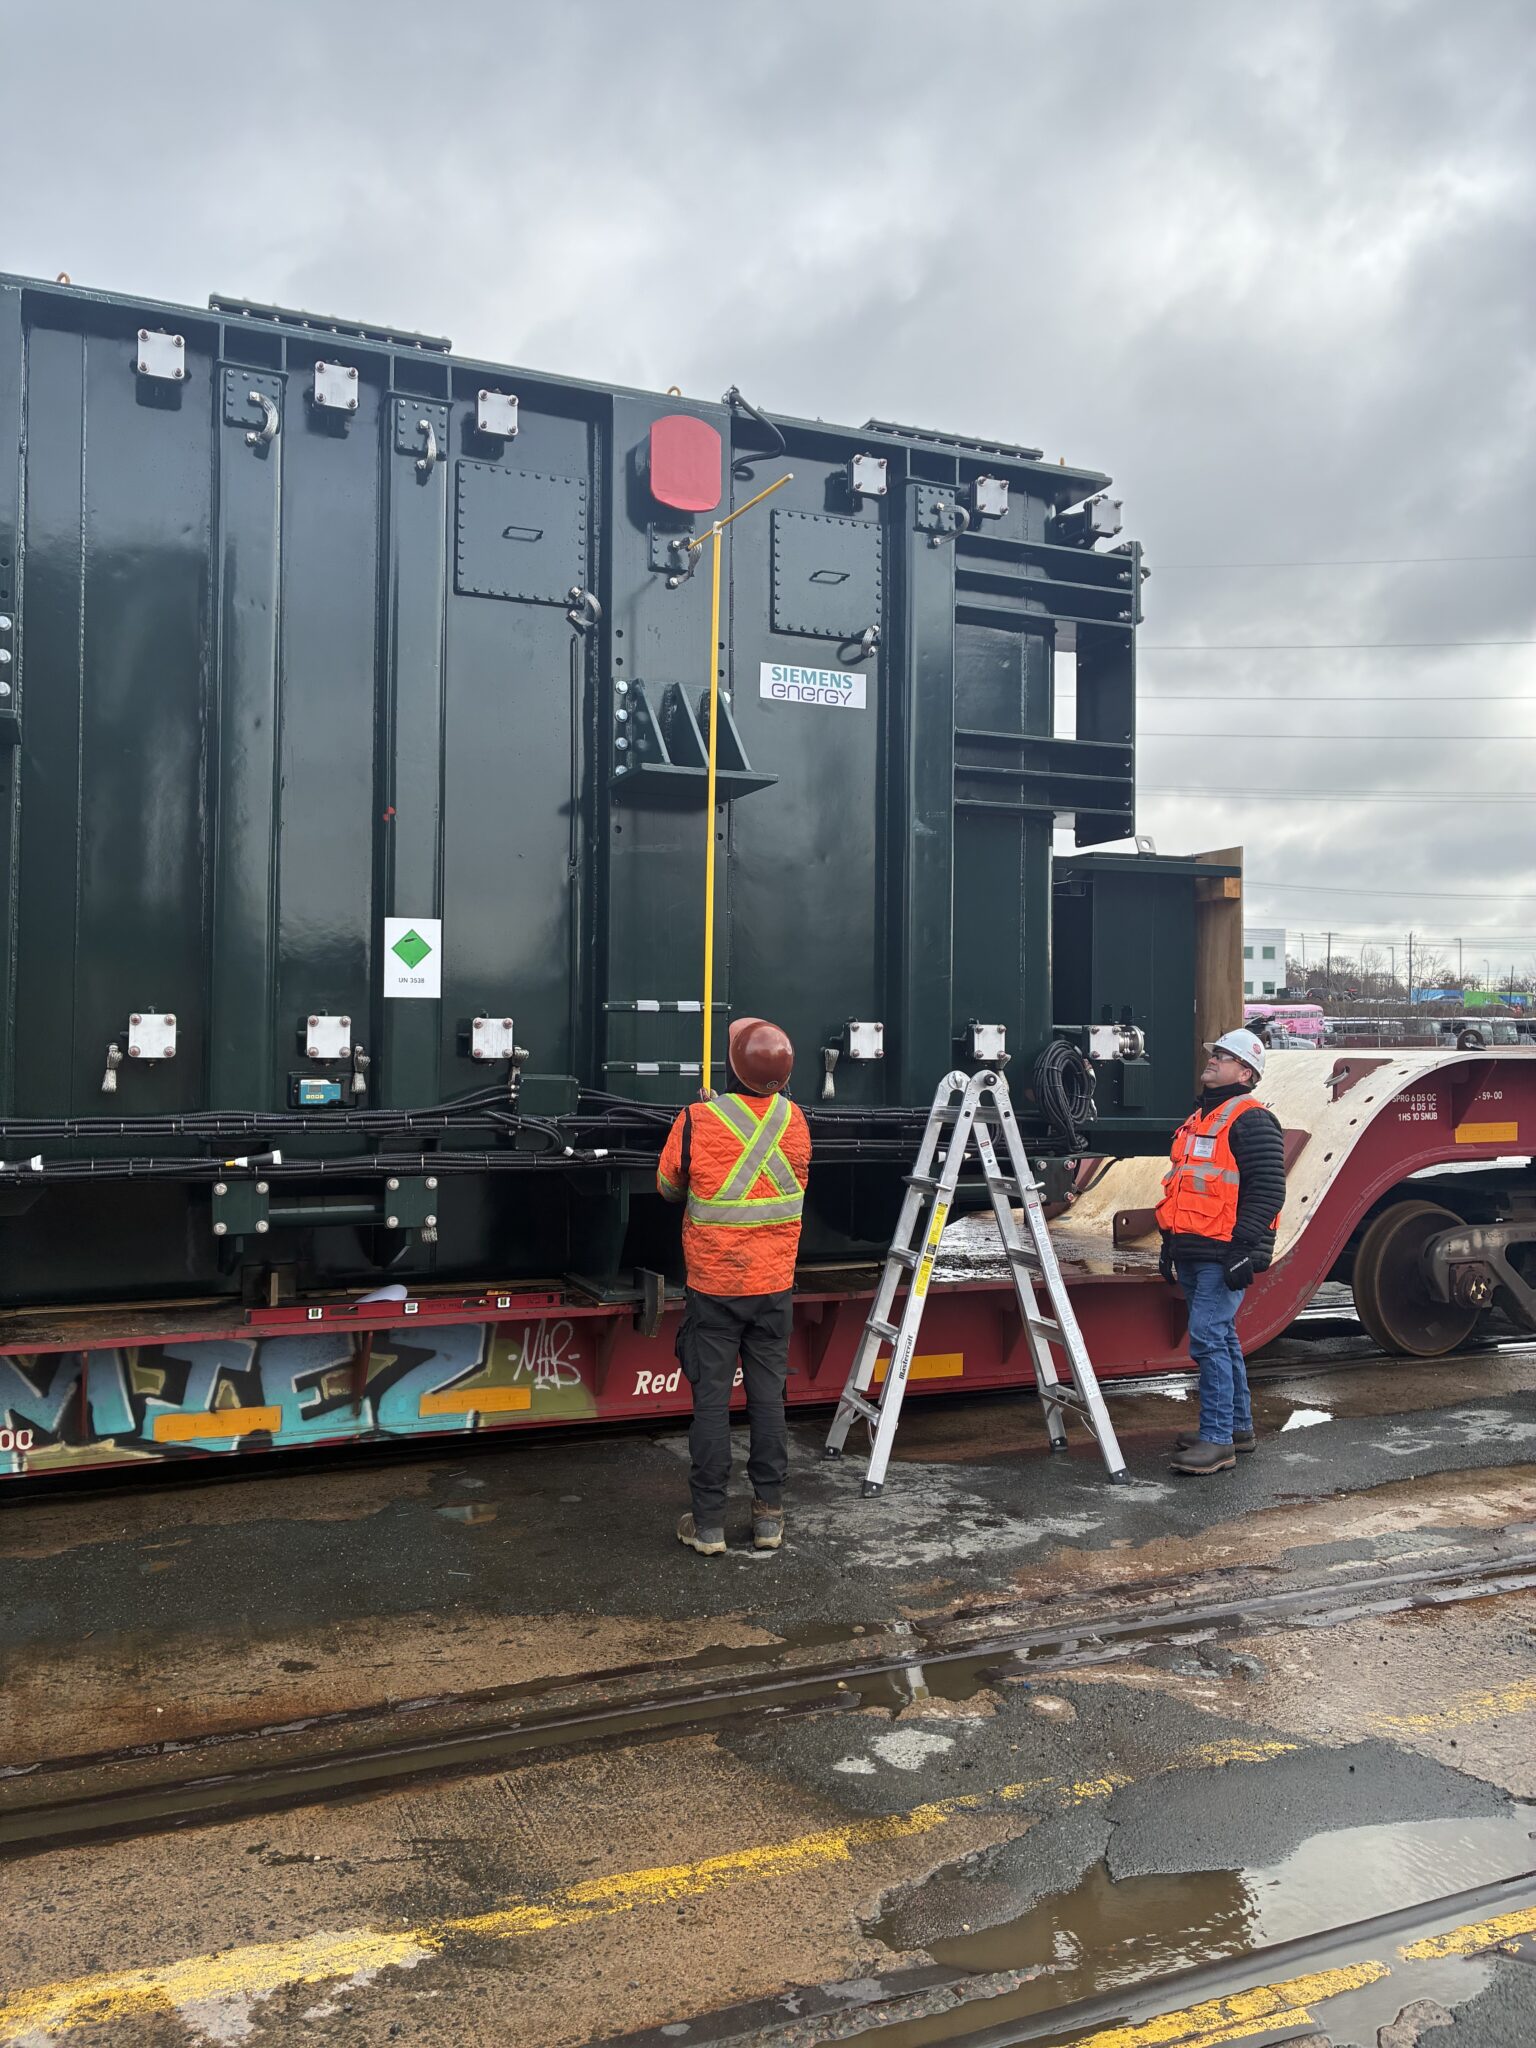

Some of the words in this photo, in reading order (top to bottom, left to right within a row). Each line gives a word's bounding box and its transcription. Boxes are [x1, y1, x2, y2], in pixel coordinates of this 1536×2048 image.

[771, 666, 853, 689] SIEMENS
[1411, 1094, 1416, 1102] 6
[1410, 1102, 1416, 1111] 4
[1420, 1112, 1438, 1121] SNUB
[899, 1334, 914, 1380] Mastercraft
[632, 1367, 682, 1396] Red
